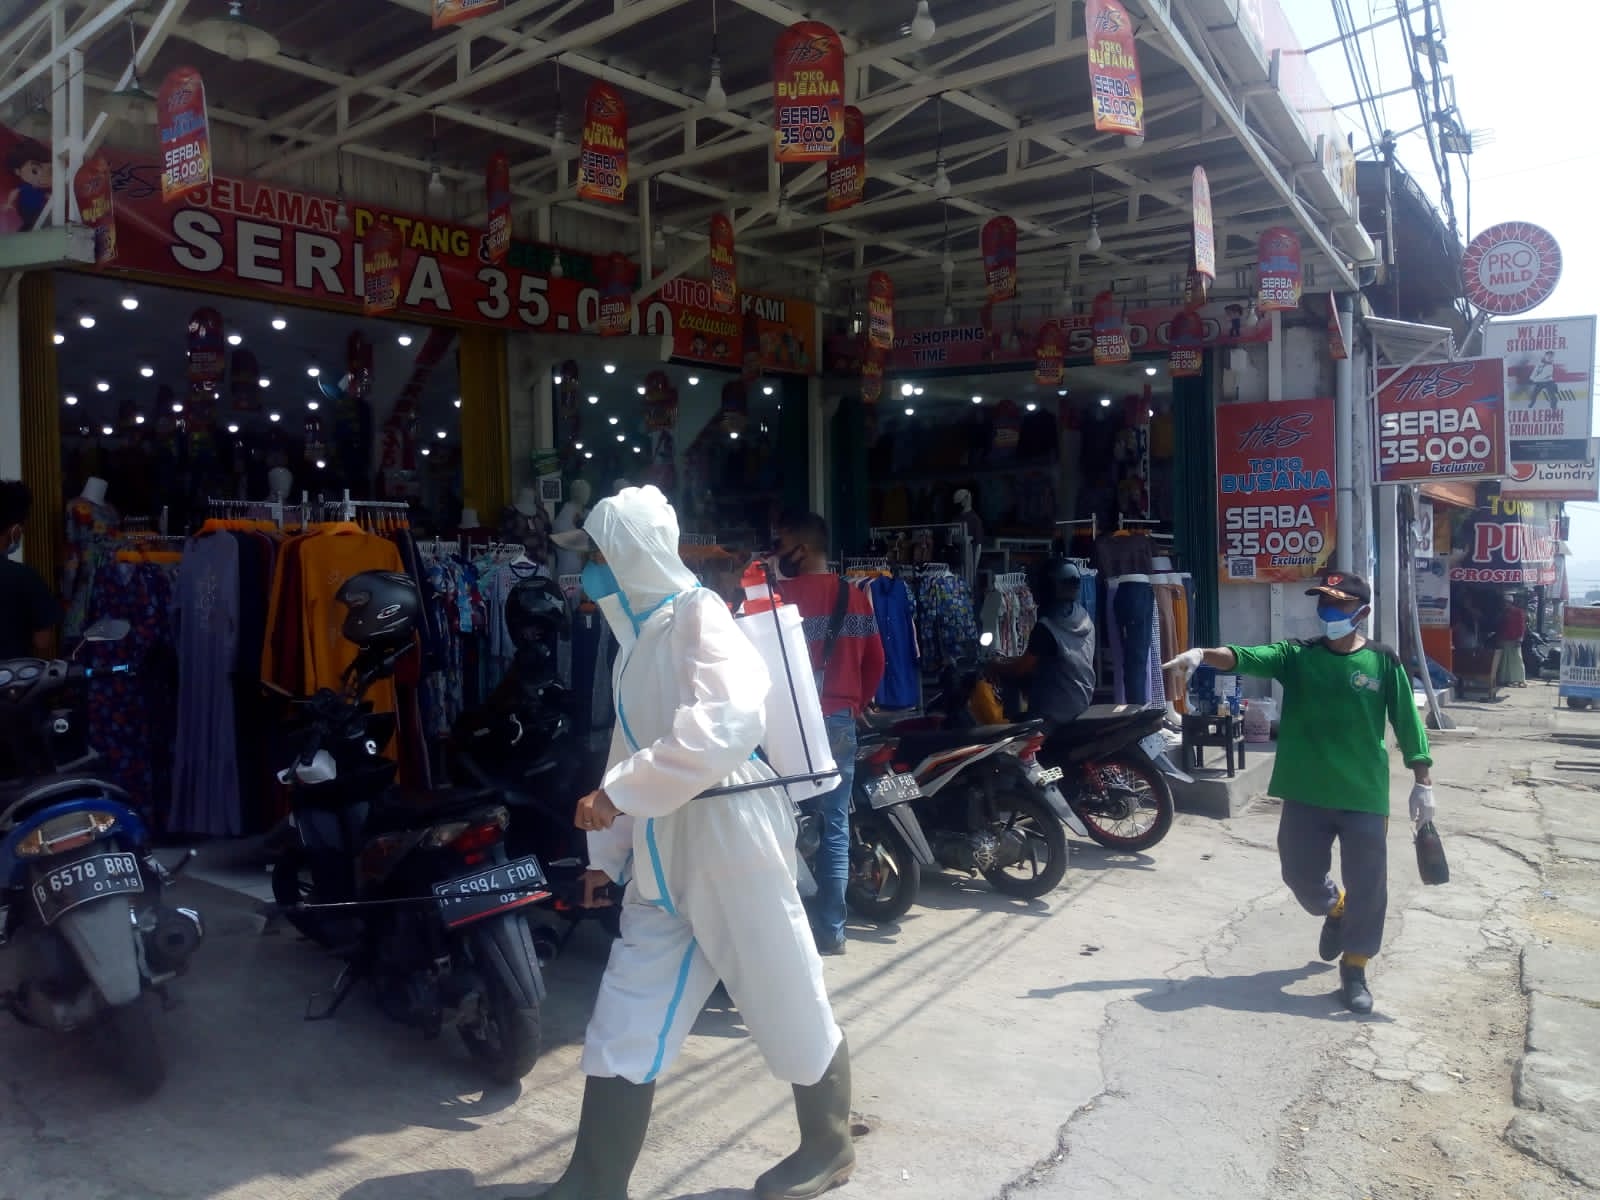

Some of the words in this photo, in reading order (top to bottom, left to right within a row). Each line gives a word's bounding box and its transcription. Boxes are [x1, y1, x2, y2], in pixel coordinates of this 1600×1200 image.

[793, 71, 824, 82] TOKO
[1094, 74, 1132, 98] SERBA
[778, 80, 840, 98] BUSANA
[780, 106, 831, 126] SERBA
[1096, 95, 1137, 118] 35.000
[780, 125, 836, 146] 35.000
[165, 141, 200, 168] SERBA
[166, 157, 208, 186] 35.000
[354, 207, 472, 258] DTANG
[1488, 249, 1533, 273] PRO
[1262, 277, 1293, 289] SERBA
[1489, 269, 1533, 286] MILD
[740, 293, 785, 323] KAMI
[912, 327, 985, 346] SHOPPING
[1096, 335, 1124, 346] SERBA
[1518, 326, 1534, 338] WE
[912, 350, 947, 362] TIME
[1380, 406, 1481, 438] SERBA
[1381, 434, 1491, 465] 35.000
[1248, 457, 1304, 473] TOKO
[1431, 459, 1485, 474] Exclusive
[1539, 470, 1595, 480] Laundry
[1221, 470, 1333, 494] BUSANA
[1226, 504, 1315, 530] SERBA
[1226, 530, 1324, 555] 35.000
[1271, 554, 1318, 568] Exclusive
[1450, 567, 1522, 583] GROSIR
[36, 884, 48, 902] B
[50, 862, 96, 892] 6578
[104, 857, 134, 875] BRB
